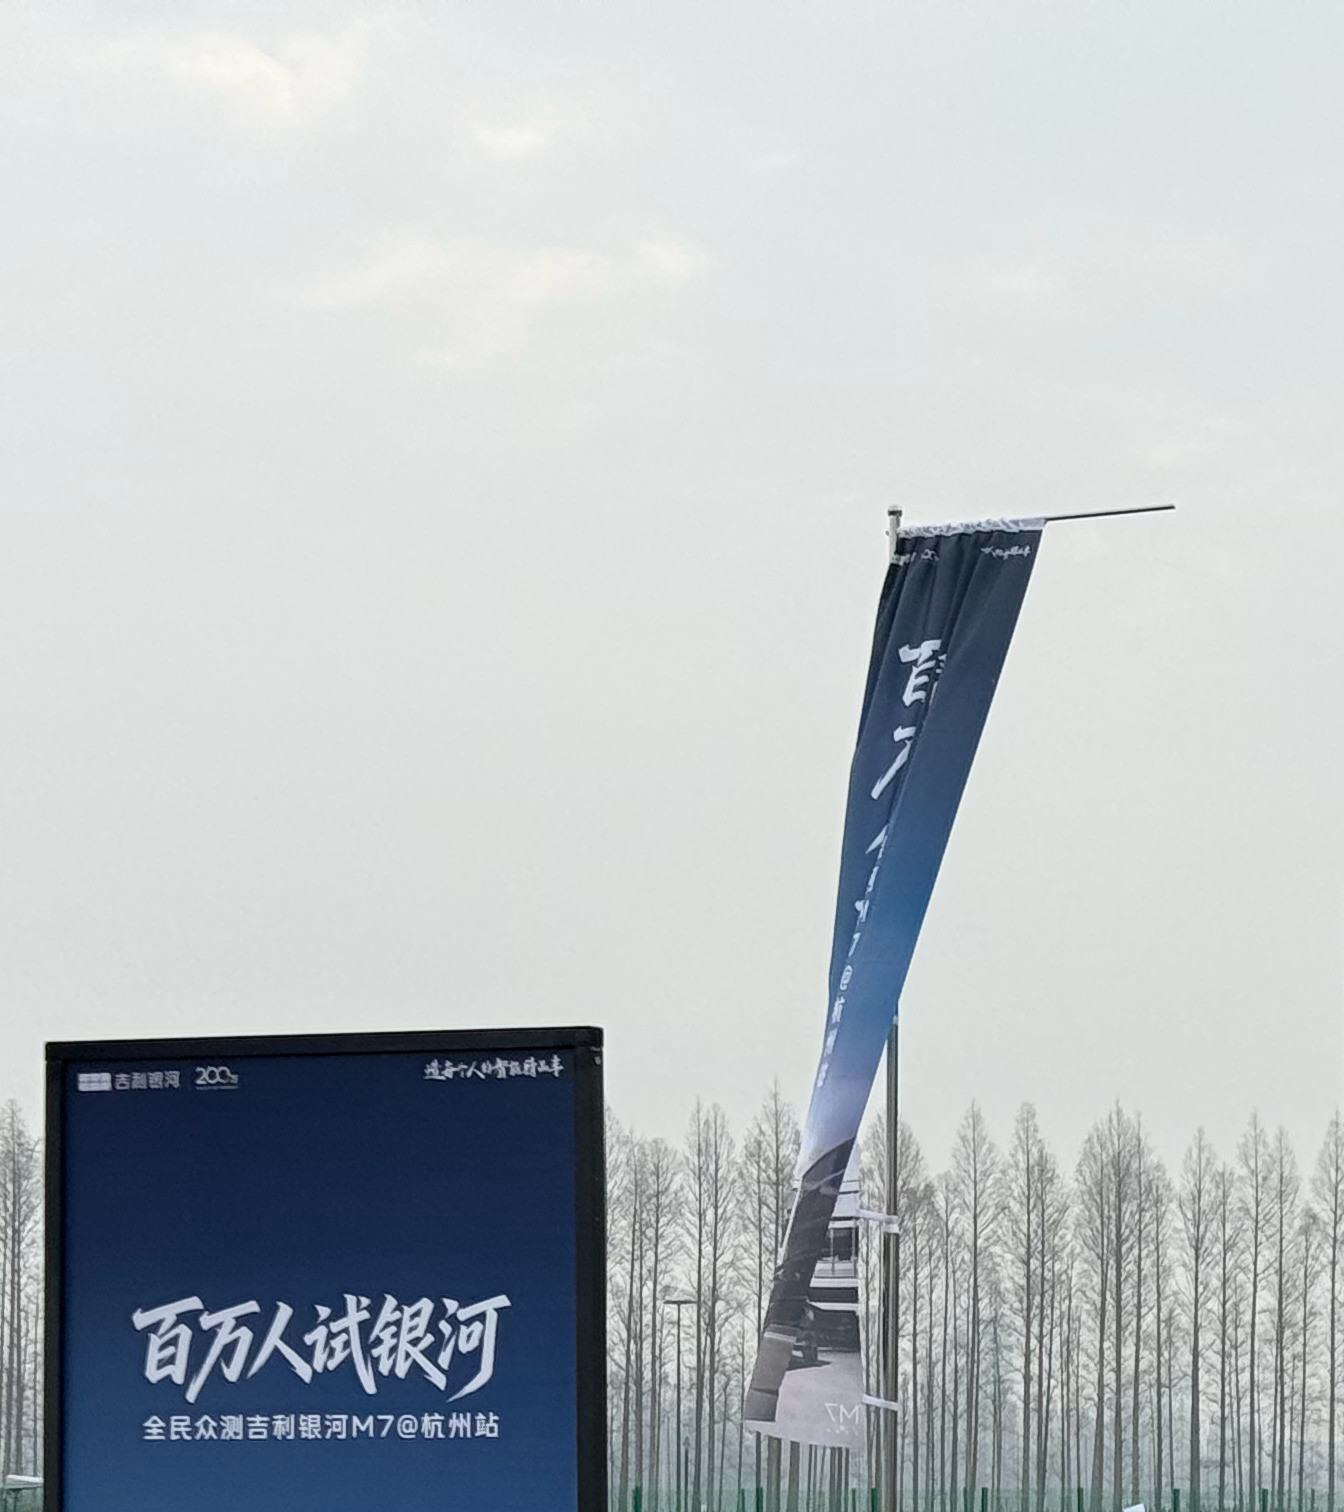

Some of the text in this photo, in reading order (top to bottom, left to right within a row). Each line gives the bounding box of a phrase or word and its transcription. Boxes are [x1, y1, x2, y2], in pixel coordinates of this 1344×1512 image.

[133, 1294, 511, 1402] 百万人试银河
[143, 1411, 500, 1441] 全民众测吉利银河M7@杭州站
